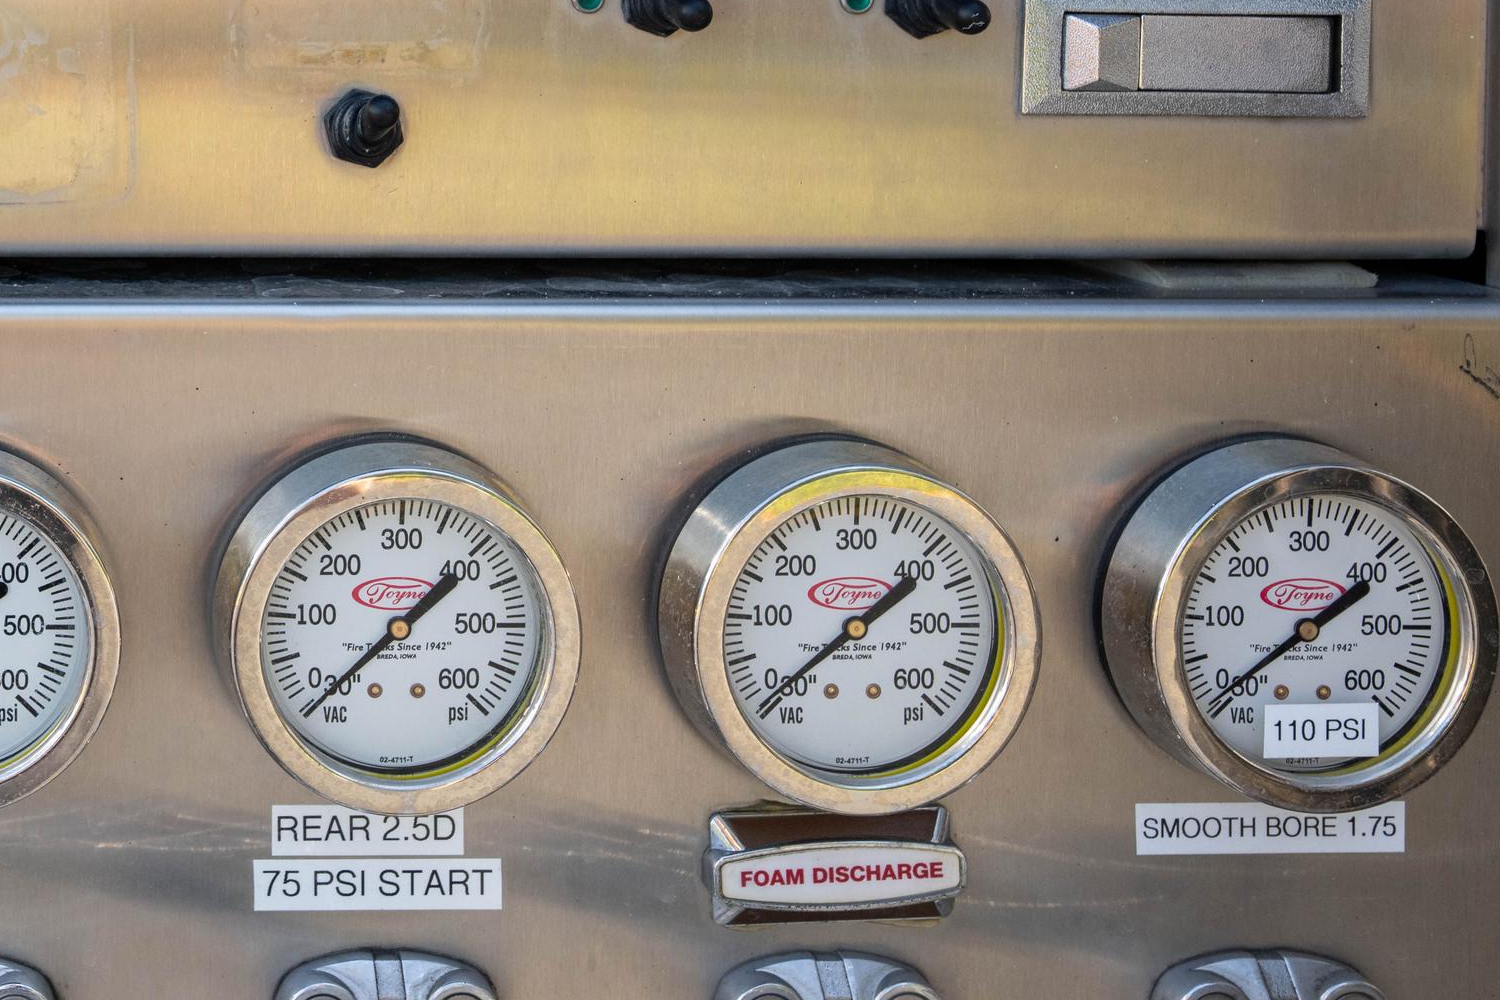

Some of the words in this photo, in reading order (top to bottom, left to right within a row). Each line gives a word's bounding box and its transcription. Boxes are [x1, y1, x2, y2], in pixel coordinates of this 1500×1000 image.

[1228, 557, 1269, 577] 200
[3, 615, 44, 635] 500
[894, 669, 934, 689] 600
[1274, 721, 1314, 740] 110
[1326, 720, 1366, 740] PSI
[276, 816, 370, 841] REAR
[382, 815, 456, 841] 2.5D
[1143, 818, 1256, 839] SMOOTH
[1266, 817, 1337, 838] BORE
[1348, 816, 1397, 837] 1.75
[262, 871, 300, 897] 75
[313, 871, 366, 896] PSI
[379, 870, 492, 896] START
[741, 870, 804, 887] FOAM
[812, 862, 943, 884] DISCHARGE
